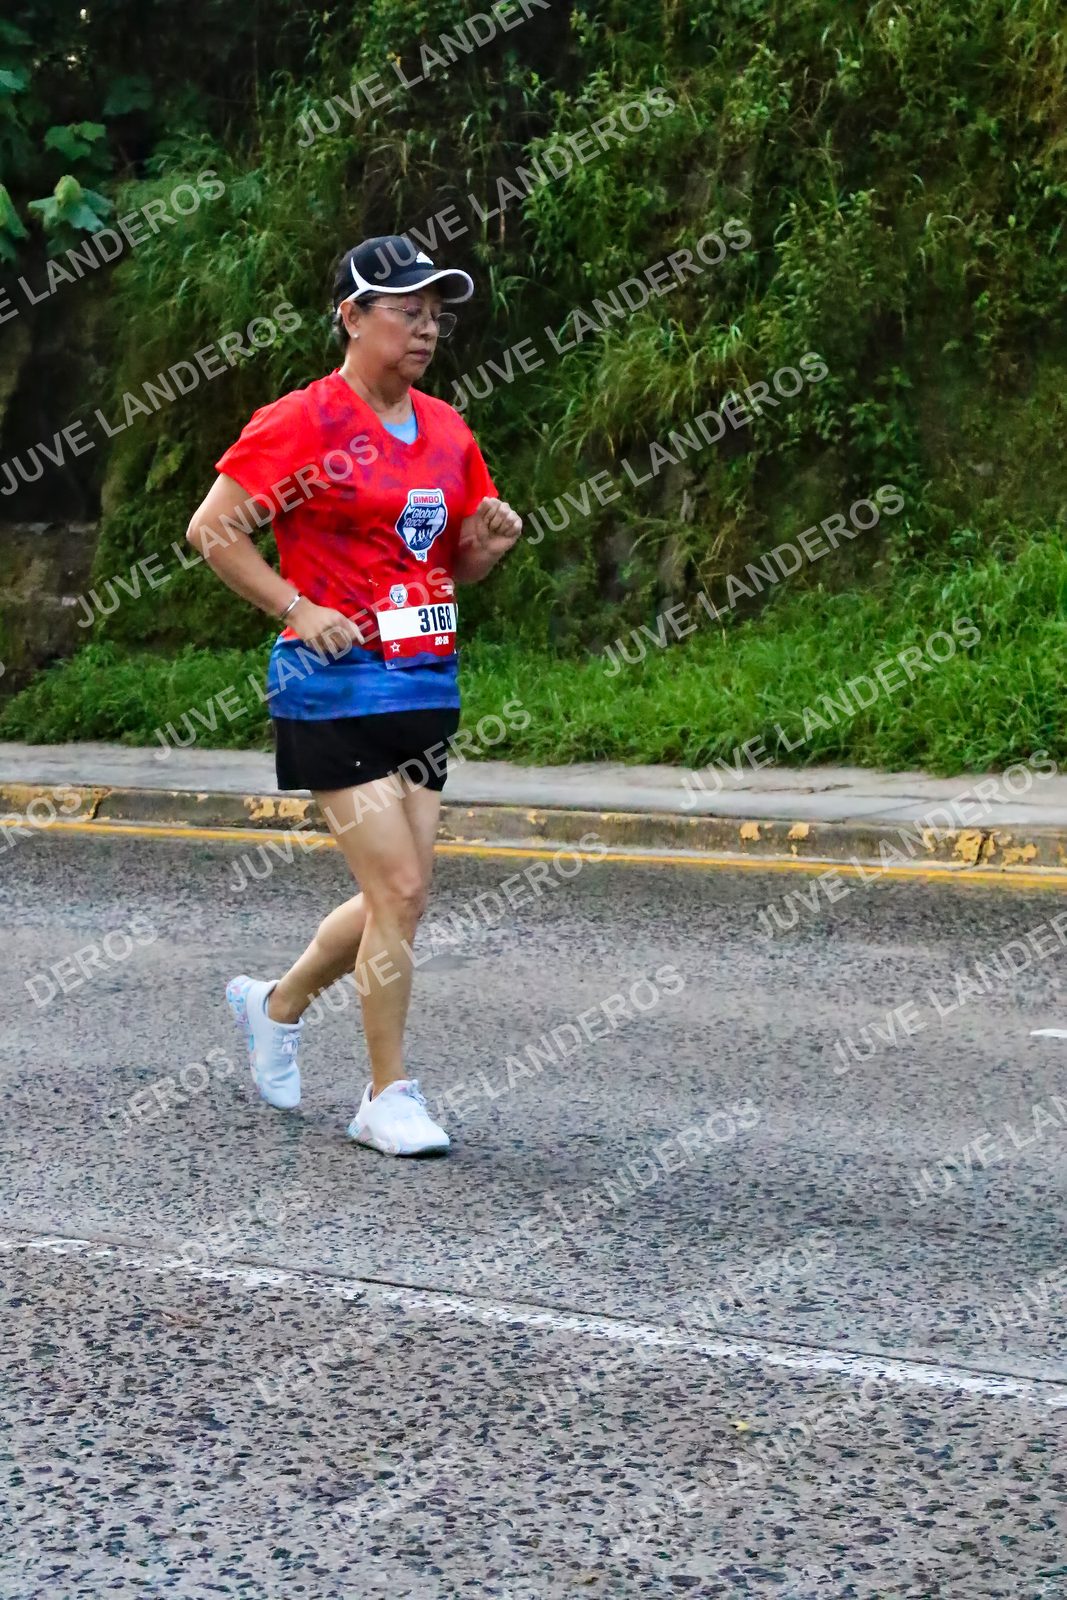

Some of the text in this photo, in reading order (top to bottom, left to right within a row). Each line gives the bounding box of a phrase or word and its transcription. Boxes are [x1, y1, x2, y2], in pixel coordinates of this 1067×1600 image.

[413, 496, 440, 504] BIMBO
[412, 507, 439, 519] Global
[403, 518, 425, 528] Race
[418, 605, 452, 633] 3168
